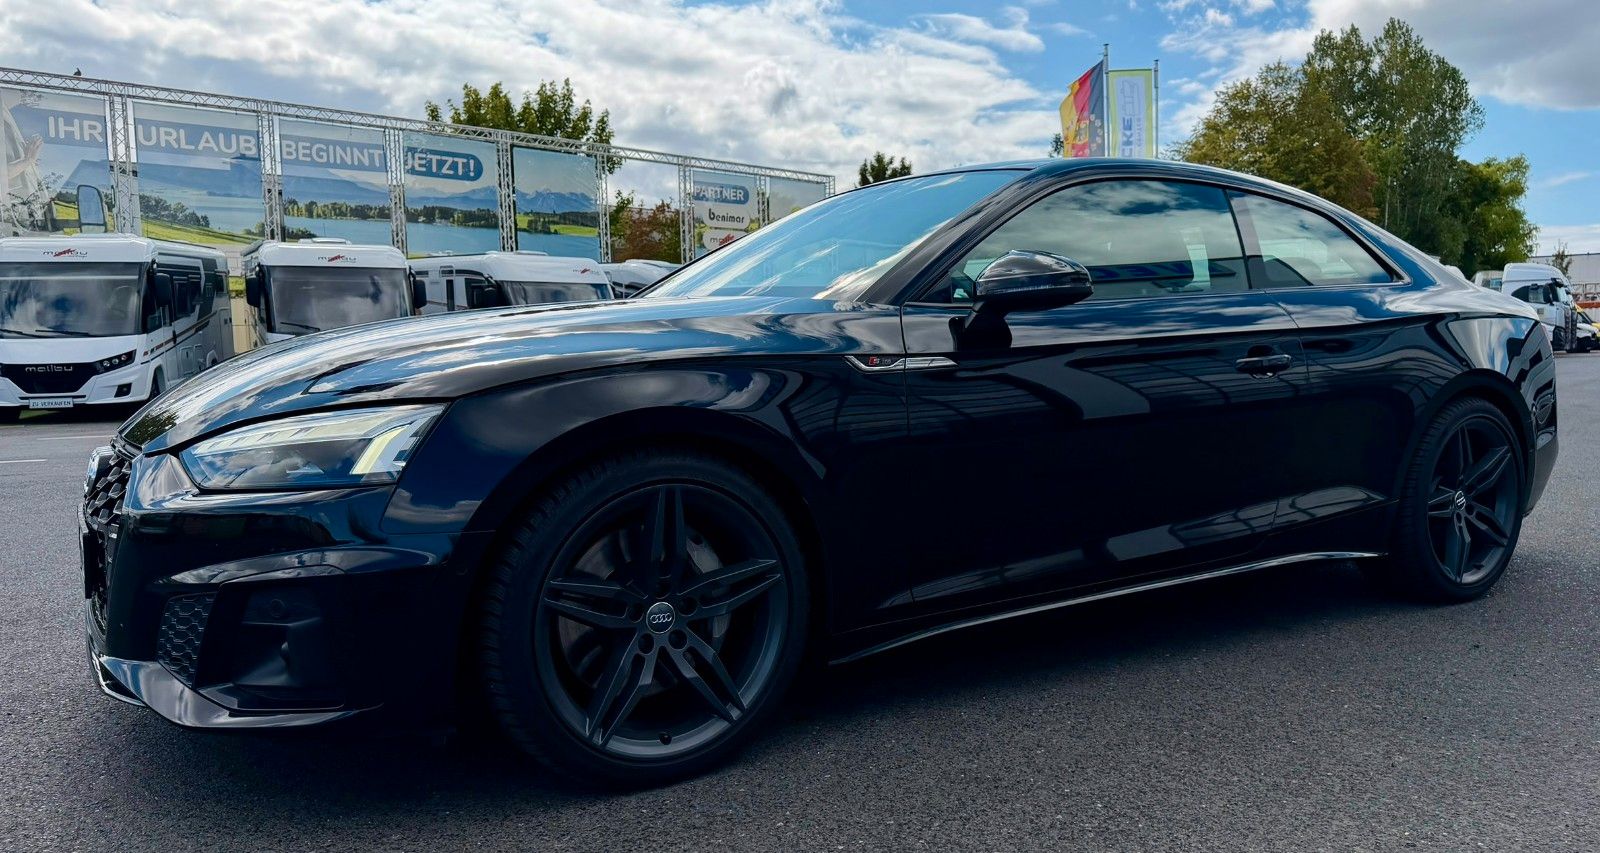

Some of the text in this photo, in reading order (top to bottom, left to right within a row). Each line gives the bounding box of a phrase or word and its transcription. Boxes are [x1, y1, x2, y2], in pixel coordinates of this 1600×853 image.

[48, 116, 475, 177] IHR URLAUB BEGINNT JETZT!
[694, 185, 745, 201] PARTNER
[708, 207, 745, 224] benimar
[25, 364, 73, 373] malibu
